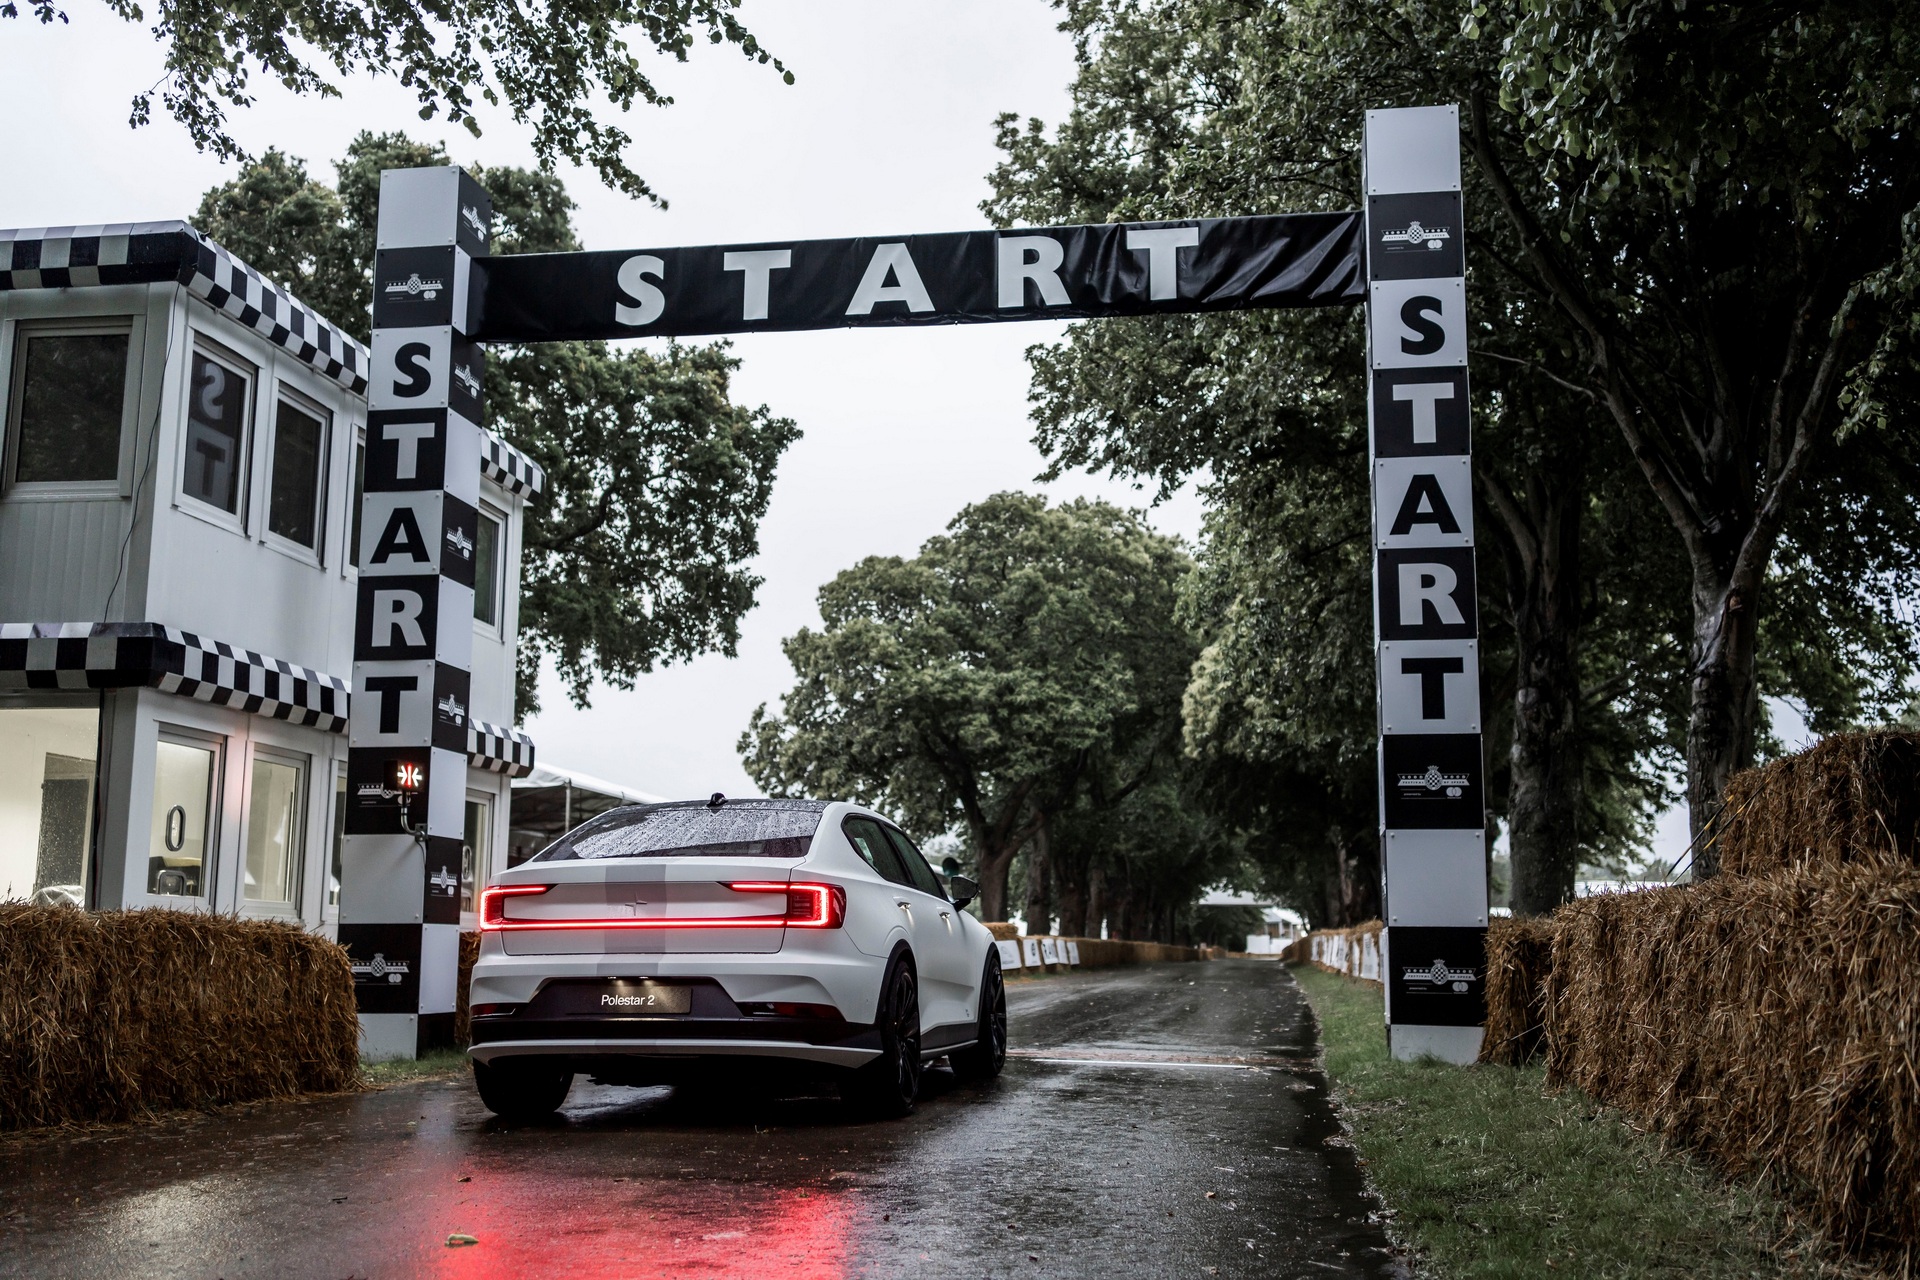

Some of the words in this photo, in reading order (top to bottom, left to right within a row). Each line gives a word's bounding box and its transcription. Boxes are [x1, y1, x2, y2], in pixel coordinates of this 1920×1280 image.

[616, 227, 1199, 325] START
[365, 342, 435, 734] START
[1390, 296, 1465, 720] START
[601, 994, 646, 1006] Polestar
[647, 994, 655, 1006] 2
